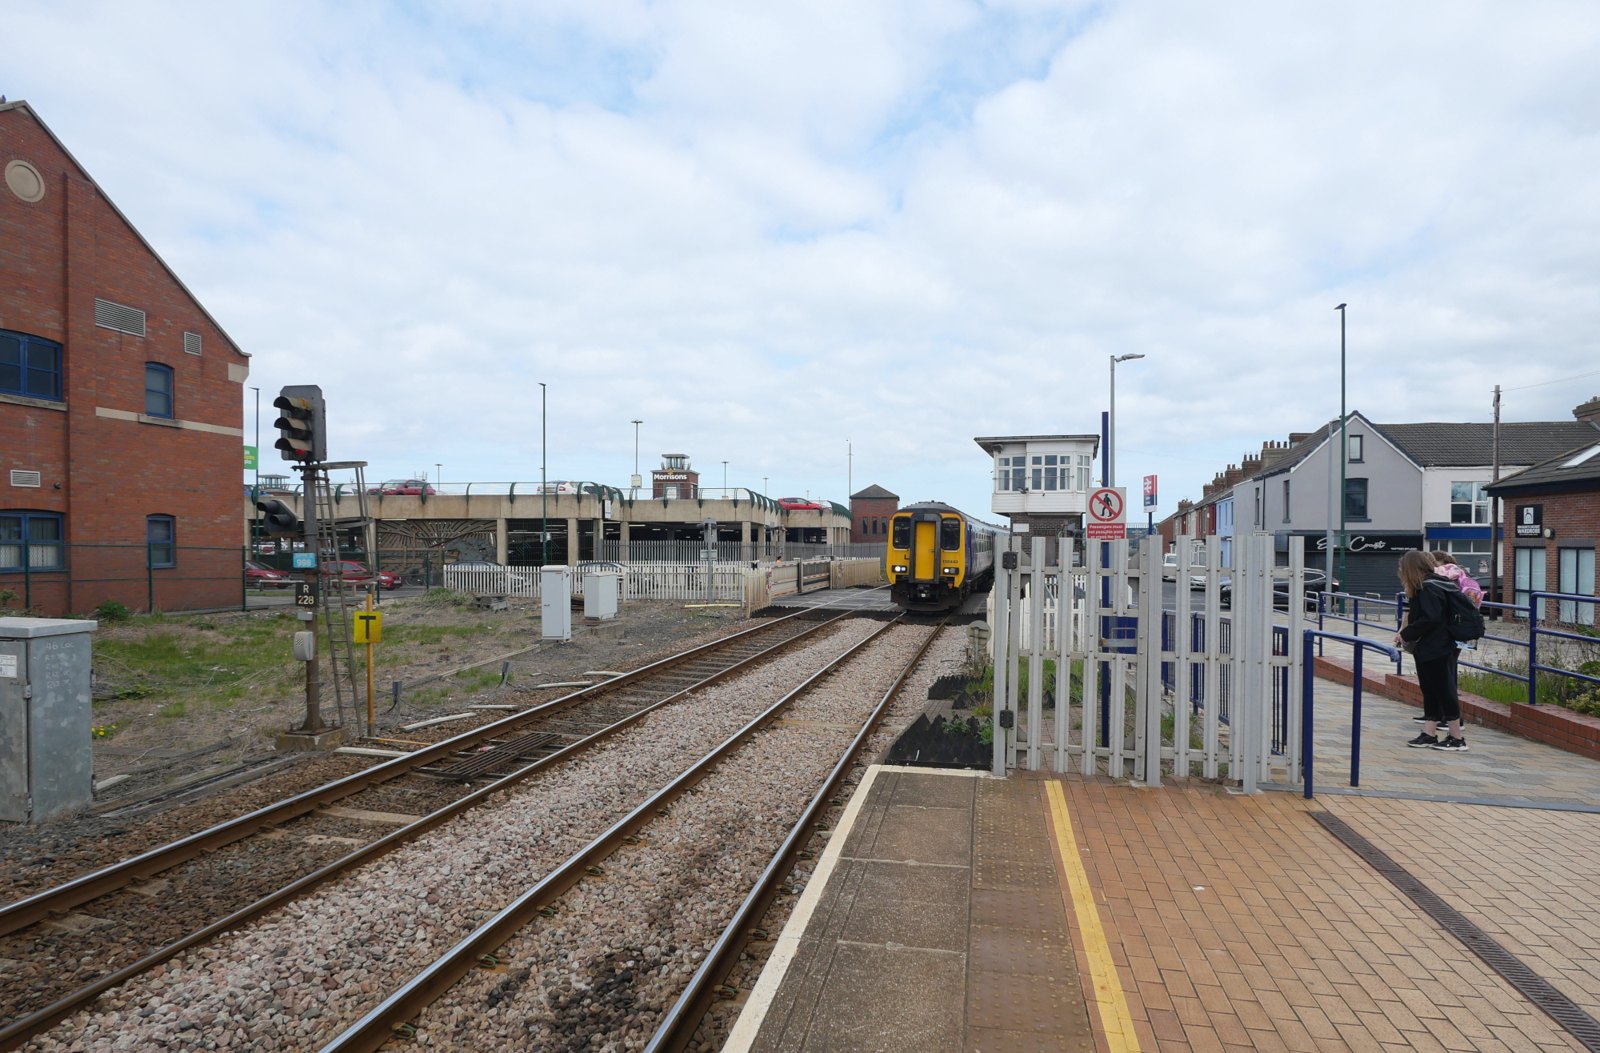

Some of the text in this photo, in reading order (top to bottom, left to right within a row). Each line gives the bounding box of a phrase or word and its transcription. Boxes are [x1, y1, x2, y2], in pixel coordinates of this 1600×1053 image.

[303, 584, 309, 593] R
[298, 595, 314, 605] 228
[359, 615, 376, 640] T
